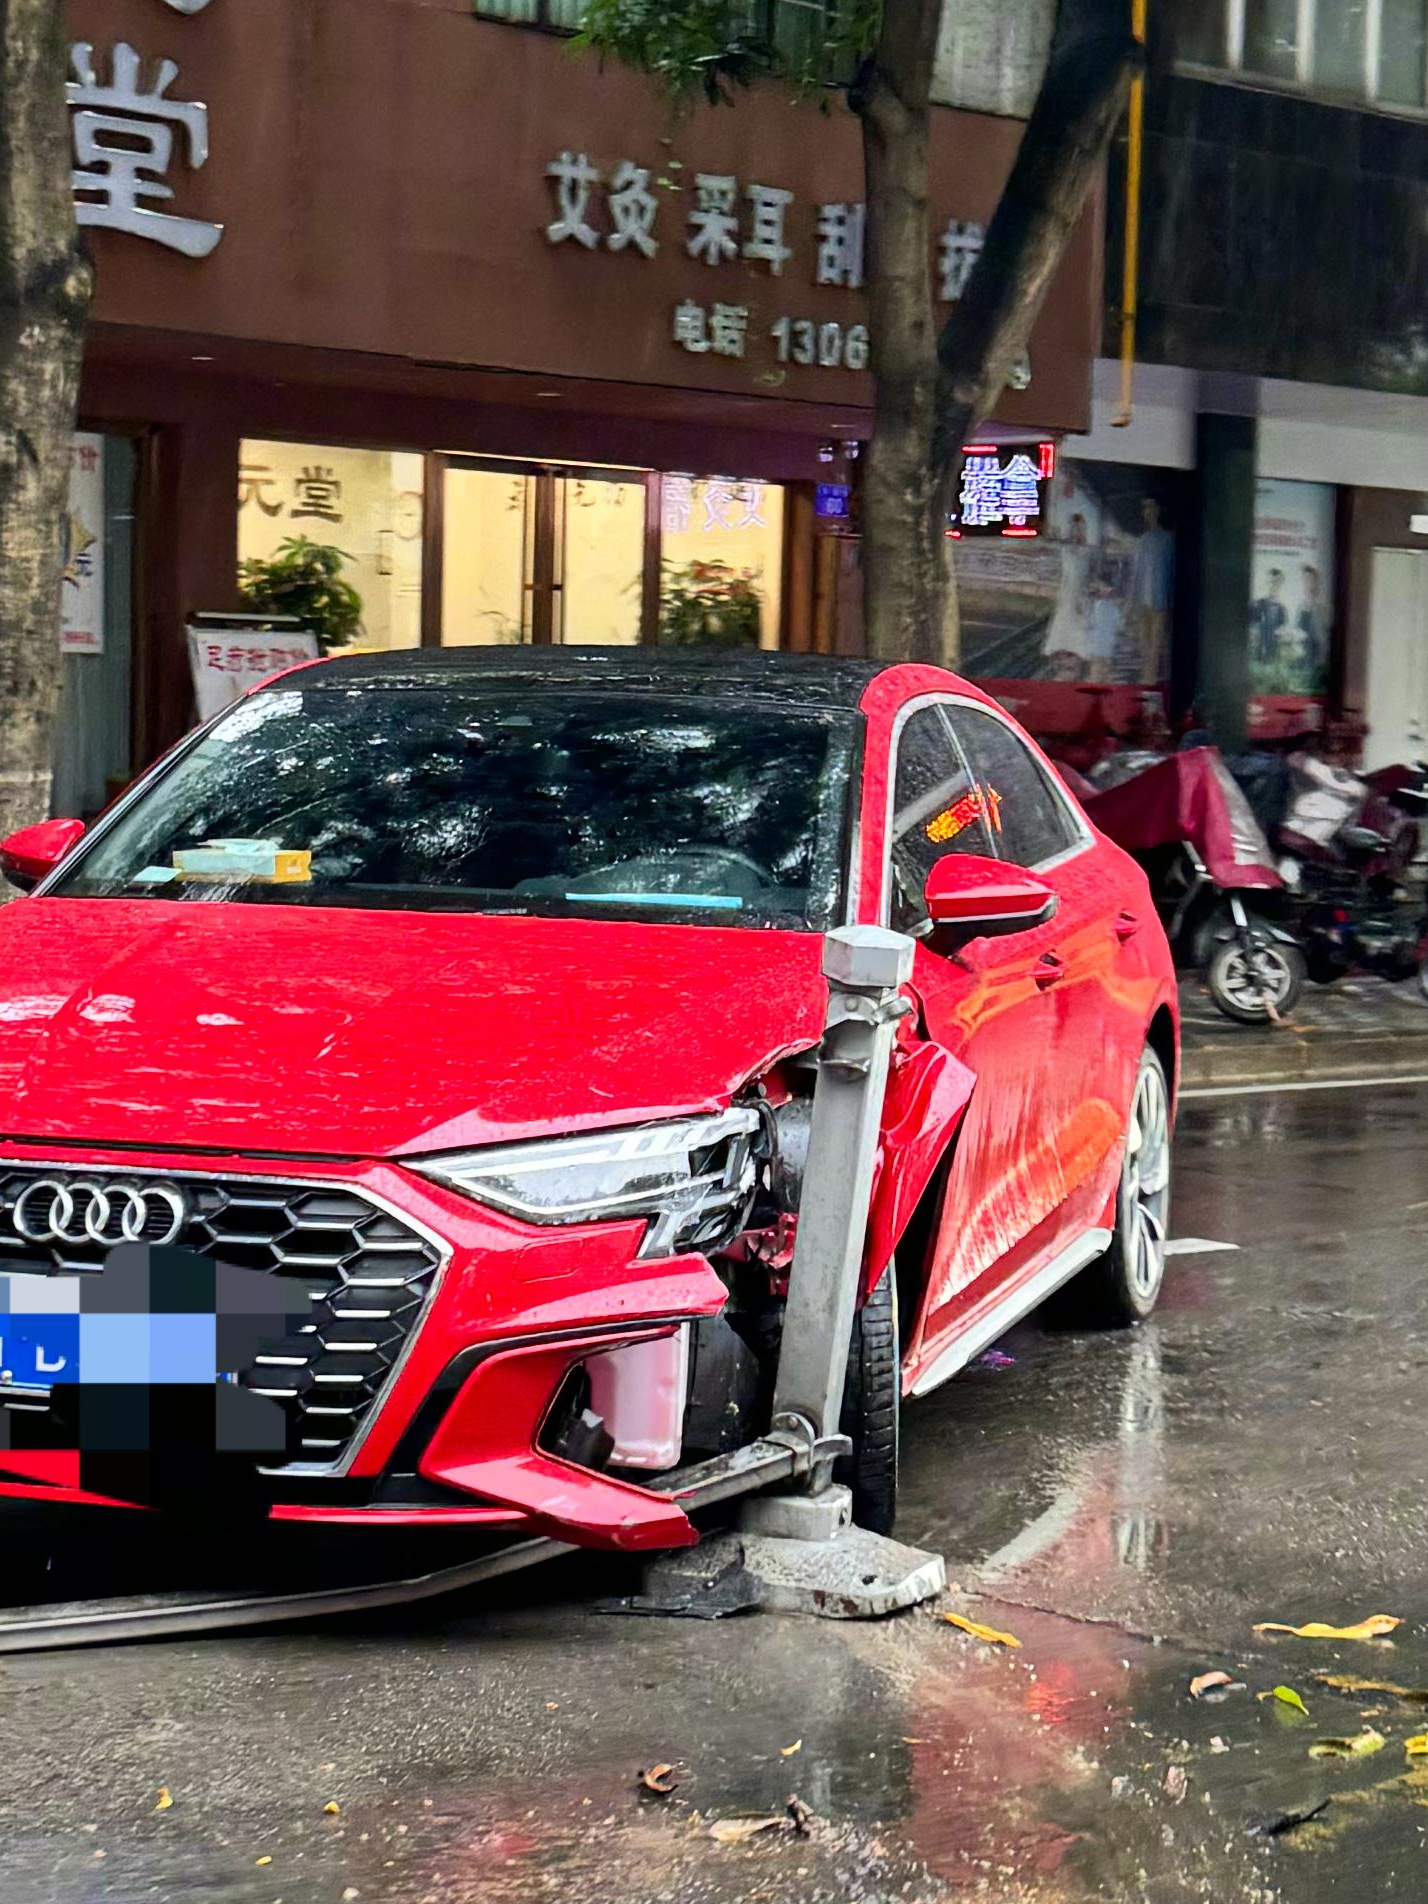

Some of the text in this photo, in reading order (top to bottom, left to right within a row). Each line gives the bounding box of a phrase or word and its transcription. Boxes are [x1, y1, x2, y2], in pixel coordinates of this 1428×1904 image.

[545, 150, 660, 259] 艾灸
[685, 172, 794, 277] 采耳
[816, 202, 868, 288] 刮
[672, 298, 870, 370] 电话 1306
